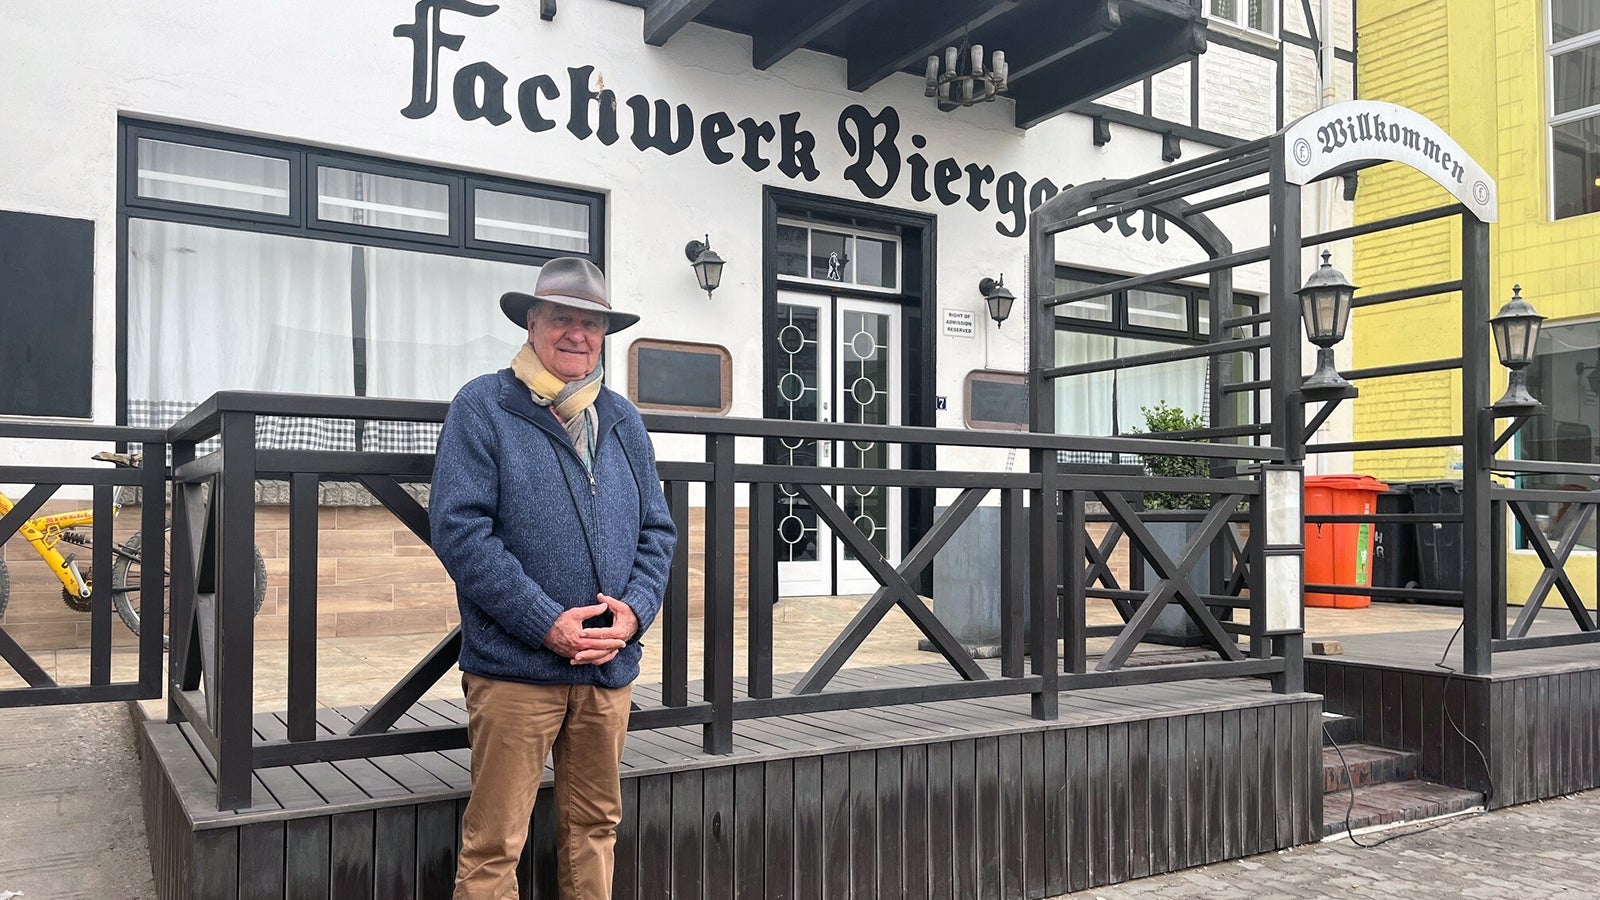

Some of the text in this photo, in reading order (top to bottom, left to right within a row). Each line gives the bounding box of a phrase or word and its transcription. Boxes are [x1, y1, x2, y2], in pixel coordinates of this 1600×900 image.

[393, 0, 820, 182] Fachwerk
[1318, 113, 1464, 183] Willkommen
[938, 398, 944, 408] 7
